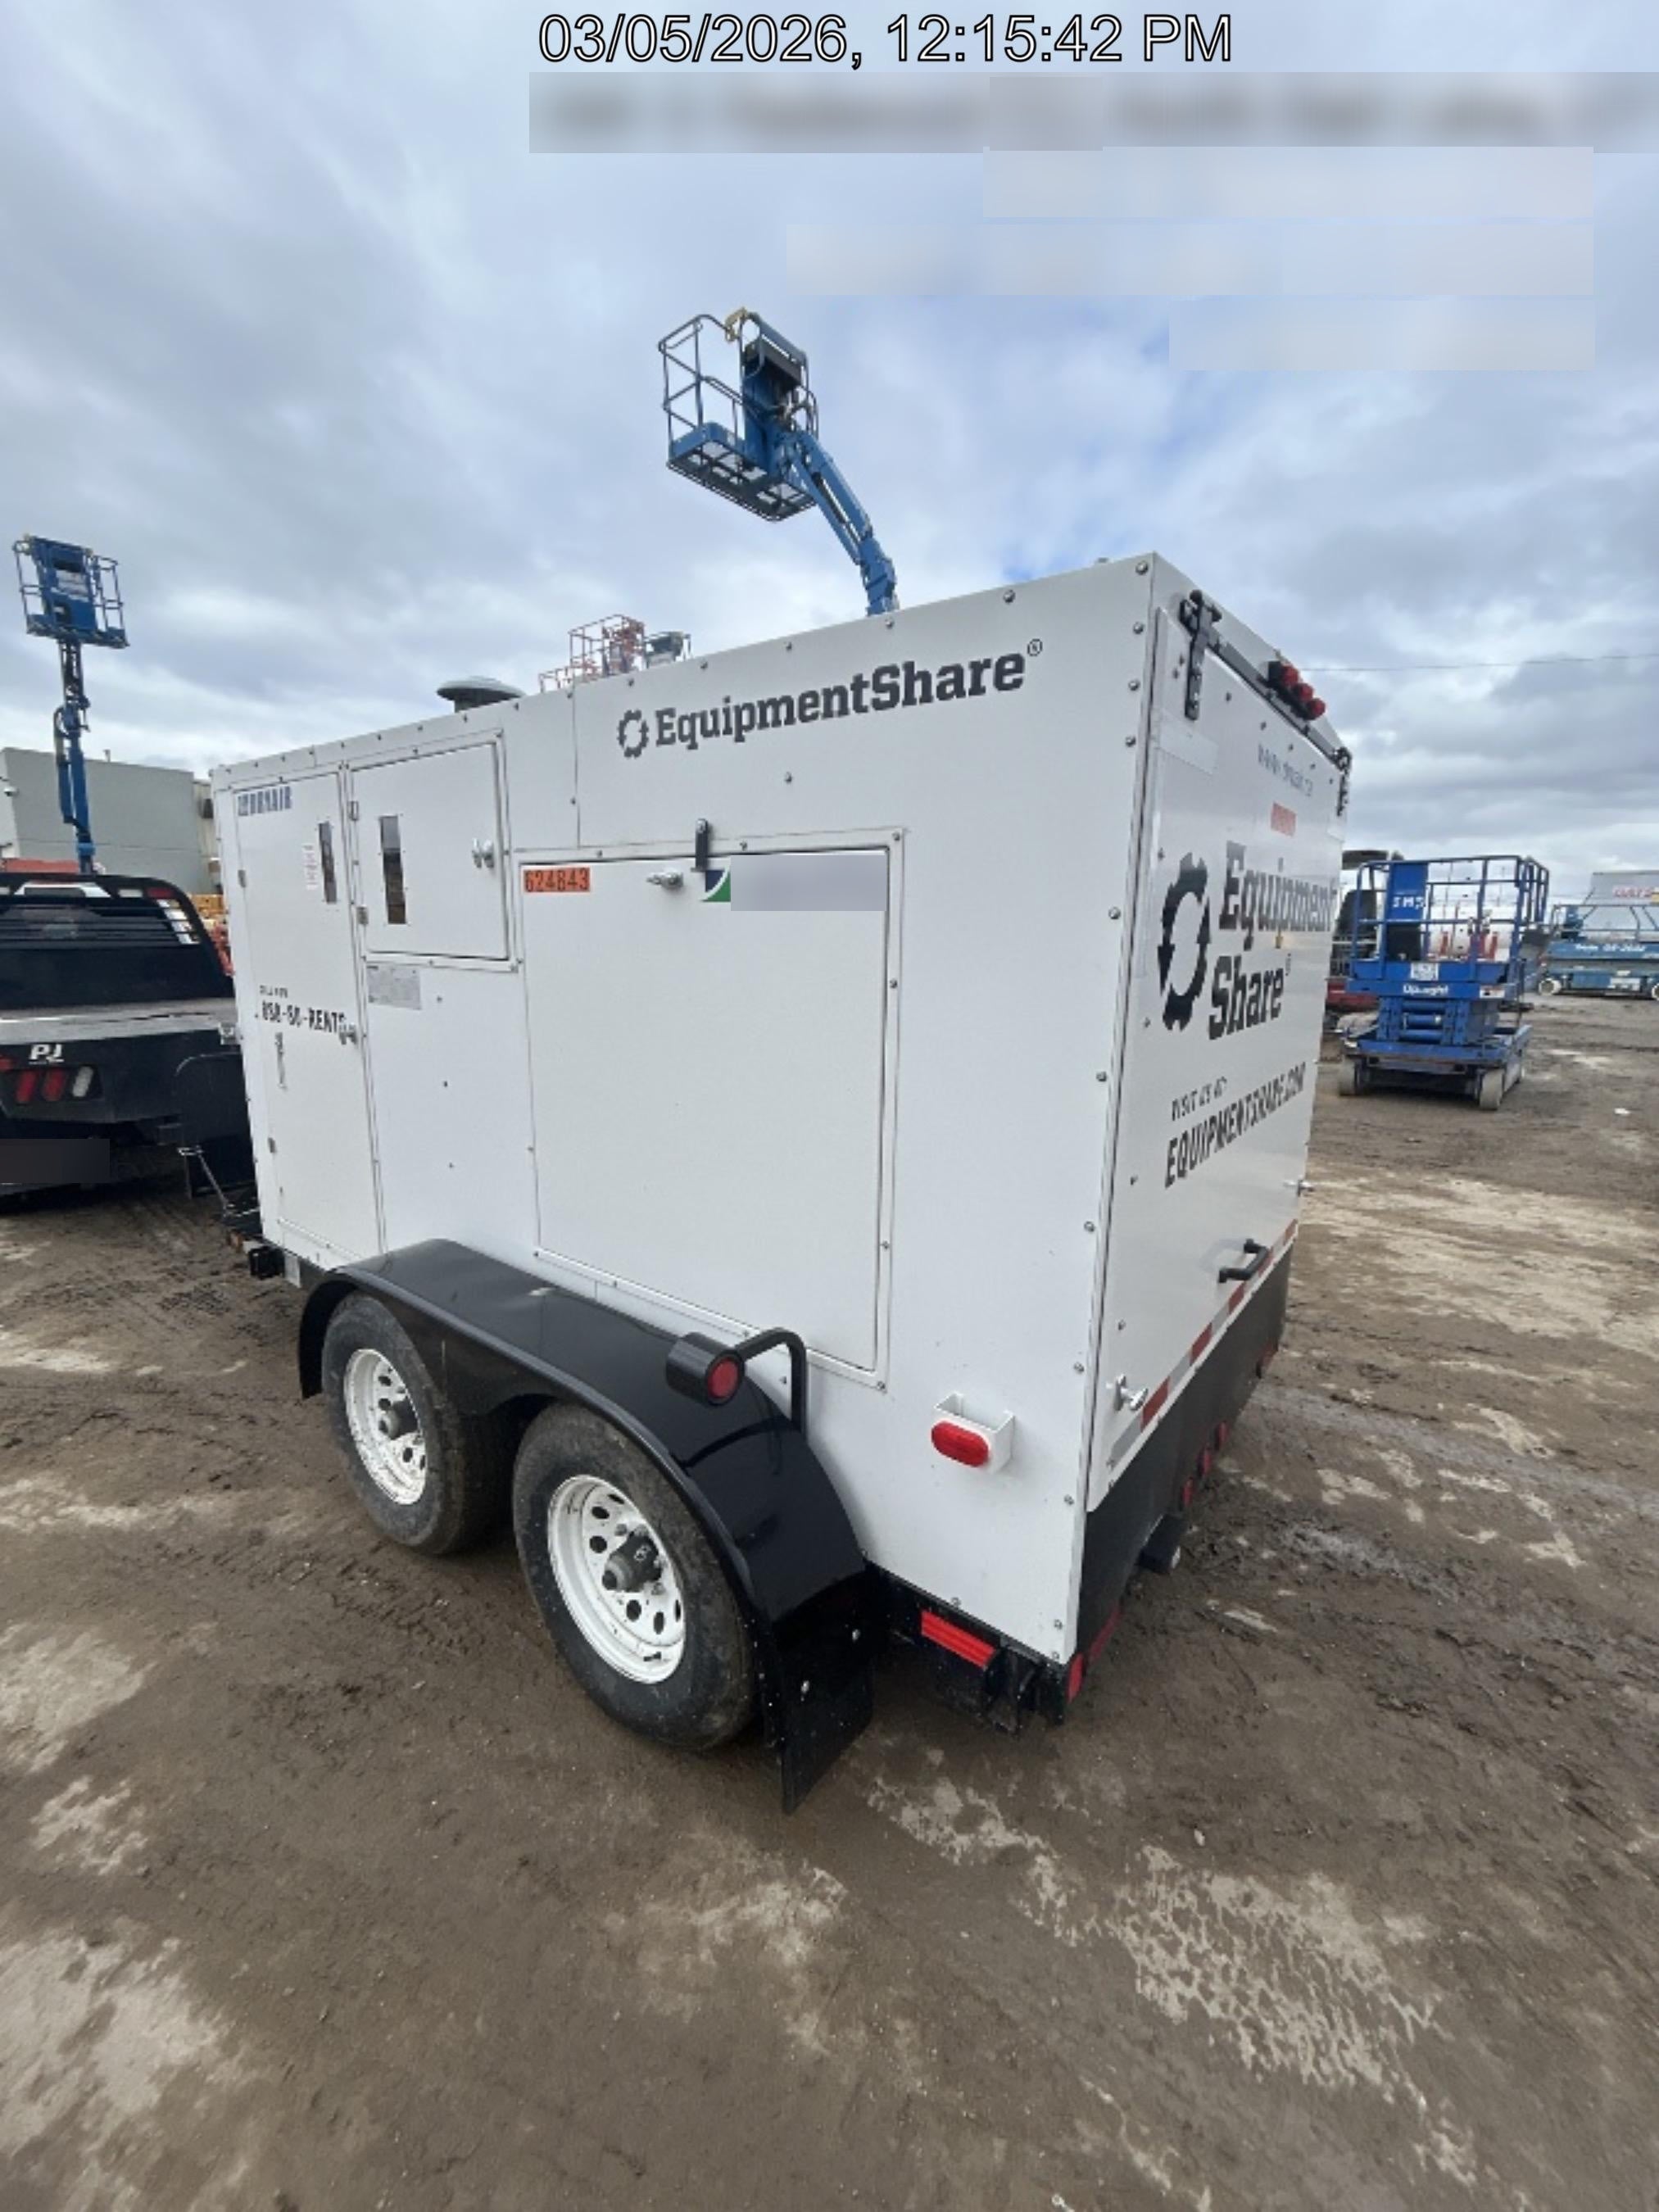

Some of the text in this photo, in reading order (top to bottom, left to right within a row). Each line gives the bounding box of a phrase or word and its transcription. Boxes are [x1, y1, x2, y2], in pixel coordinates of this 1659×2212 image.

[525, 868, 590, 893] 624843
[1208, 956, 1285, 1040] Share
[29, 1043, 64, 1063] PJ
